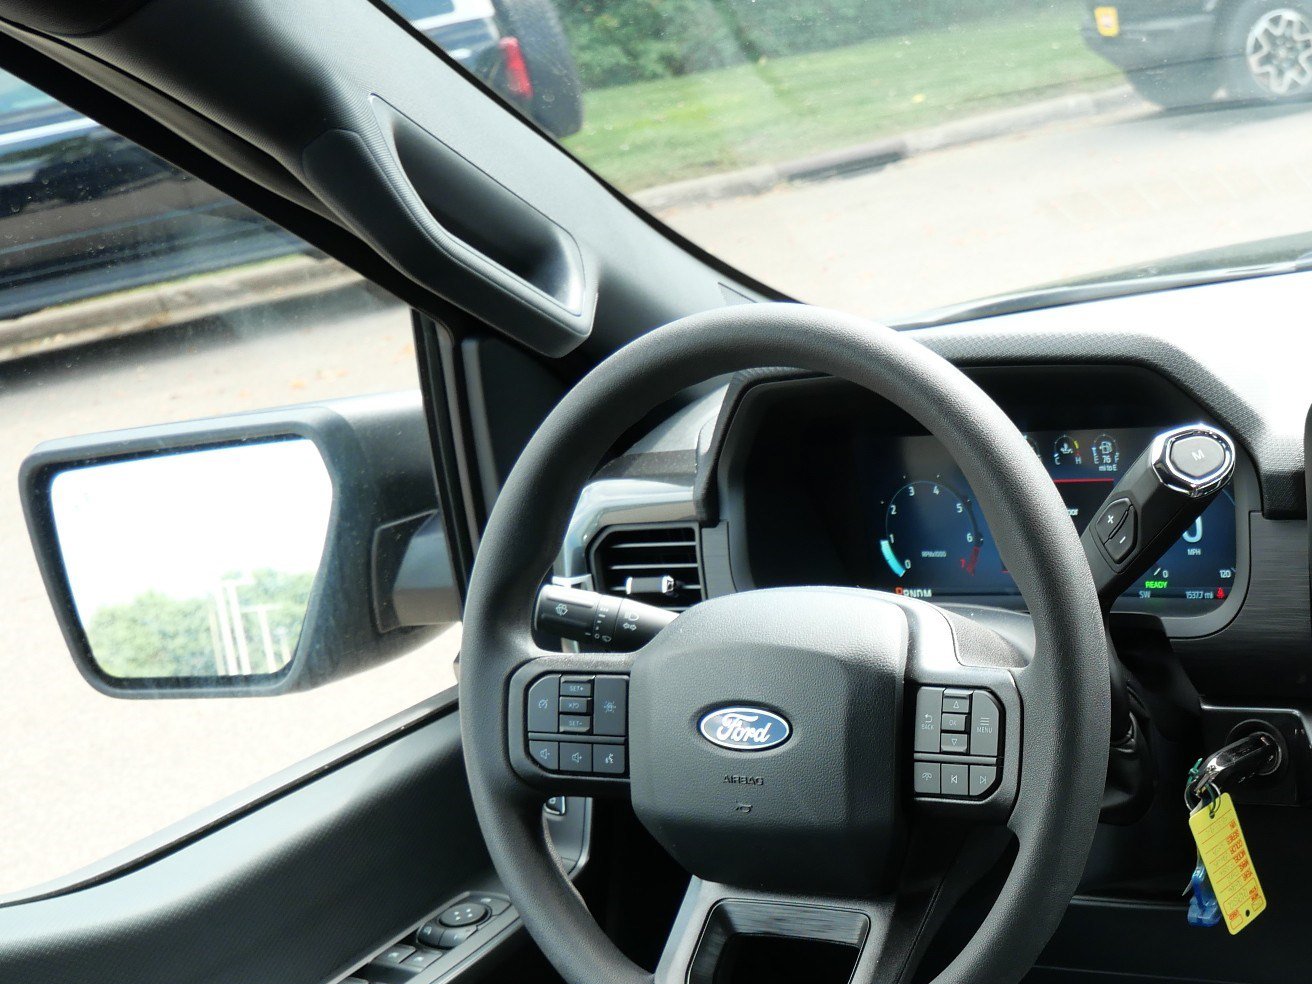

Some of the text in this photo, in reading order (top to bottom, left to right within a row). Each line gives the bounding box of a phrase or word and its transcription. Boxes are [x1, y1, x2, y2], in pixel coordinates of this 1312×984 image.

[1191, 449, 1205, 461] M
[909, 486, 915, 496] 3
[933, 486, 940, 495] 4
[891, 505, 897, 515] 2
[956, 503, 963, 513] 5
[966, 533, 973, 543] 6
[904, 560, 911, 569] 0
[717, 713, 772, 742] Ford
